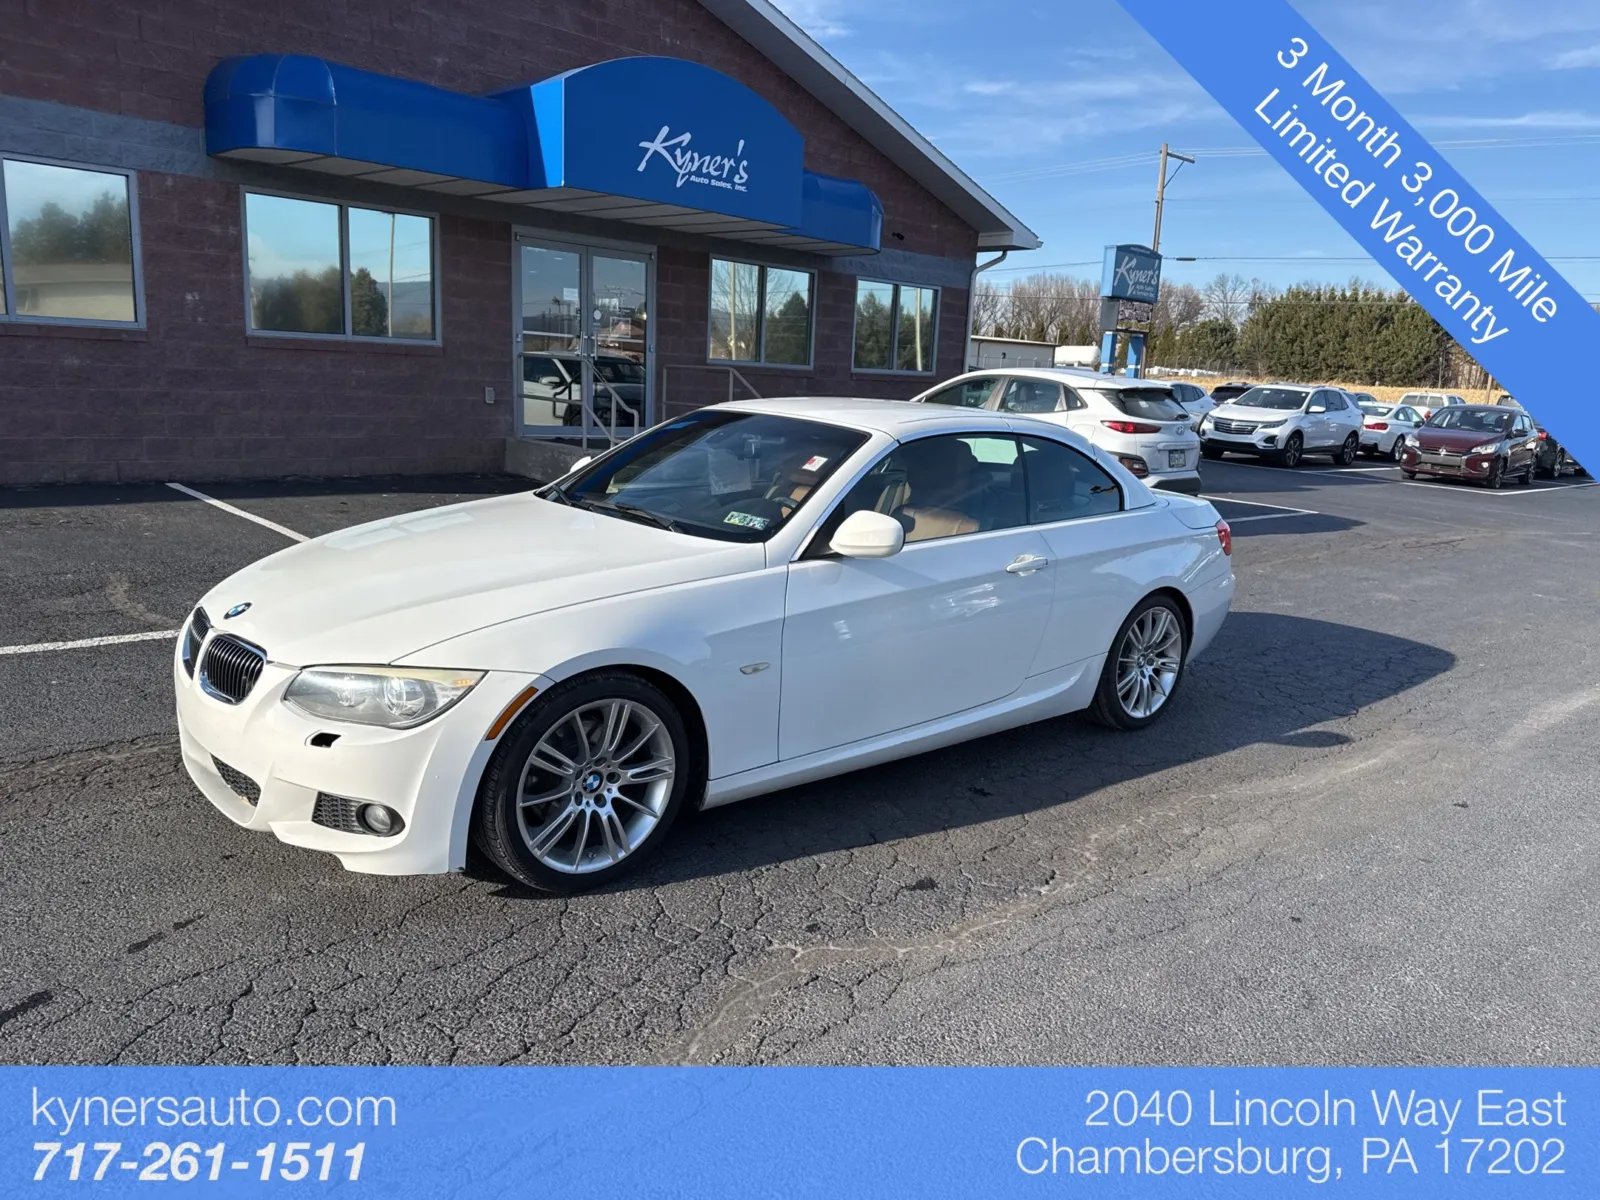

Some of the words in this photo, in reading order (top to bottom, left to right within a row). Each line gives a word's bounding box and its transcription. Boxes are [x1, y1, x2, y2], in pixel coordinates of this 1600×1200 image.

[637, 125, 748, 188] Kyner's
[690, 175, 709, 184] Auto
[710, 179, 732, 189] Sales,
[735, 184, 748, 192] Inc.
[1114, 256, 1159, 297] Kyner's
